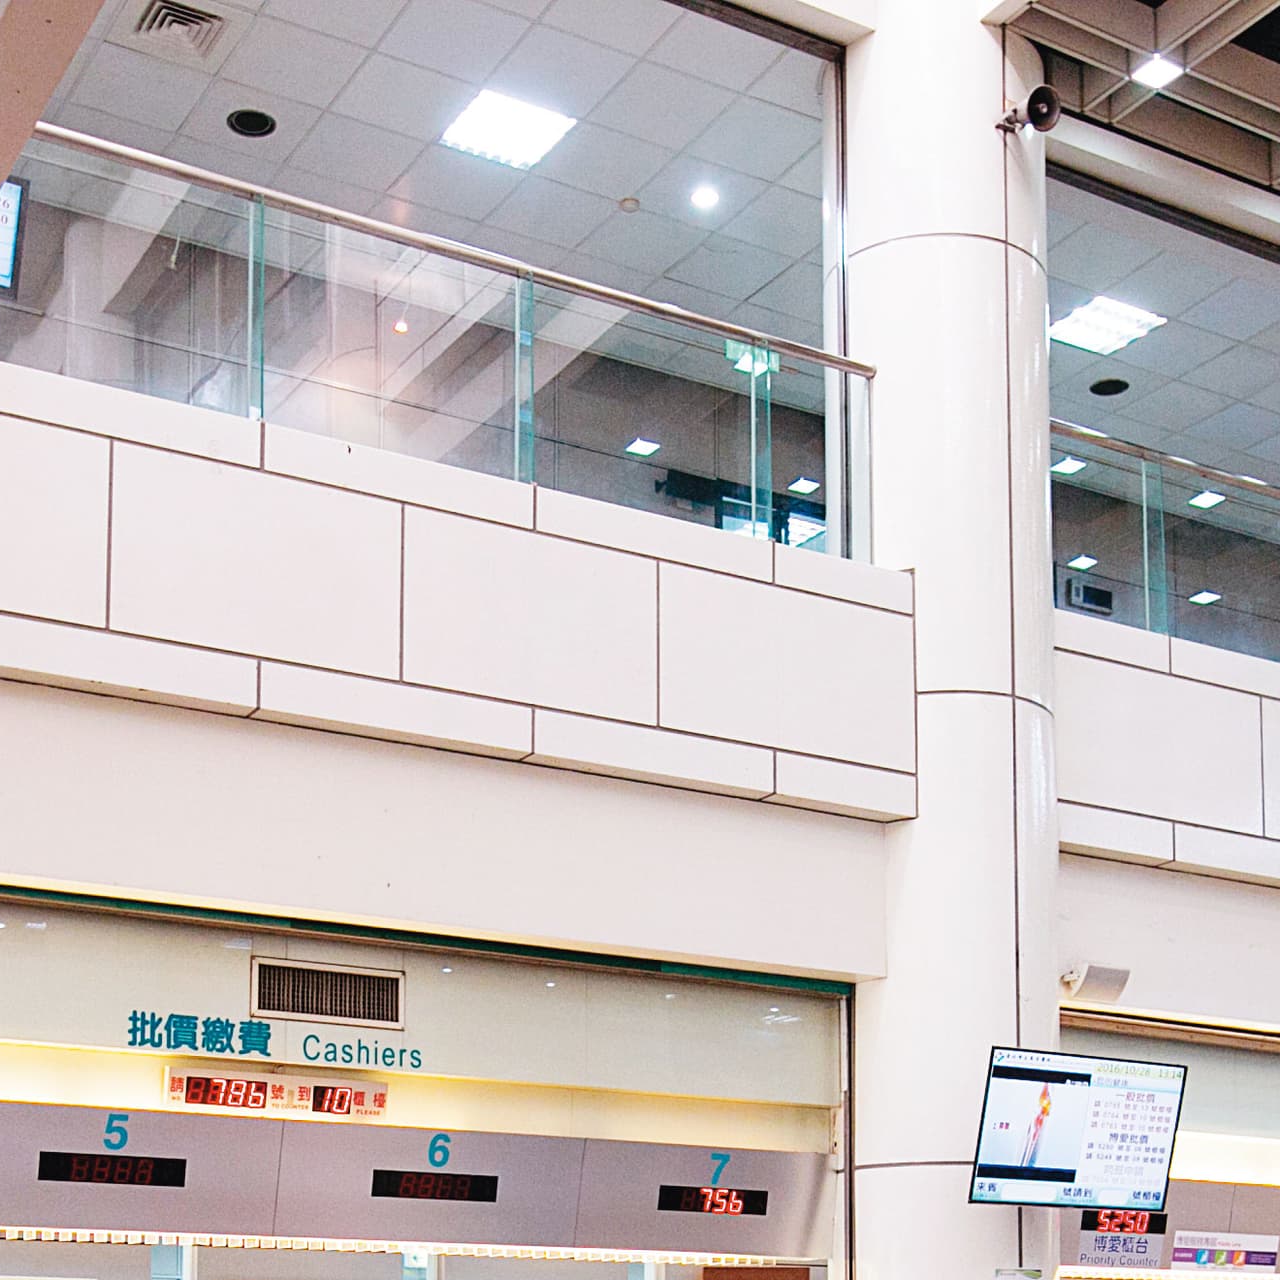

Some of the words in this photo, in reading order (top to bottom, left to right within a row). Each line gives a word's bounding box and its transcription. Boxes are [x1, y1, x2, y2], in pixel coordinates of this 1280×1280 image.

[127, 1010, 272, 1057] 批價繳費
[302, 1034, 422, 1069] Cashiers
[212, 1078, 265, 1108] 786
[323, 1088, 352, 1113] 10
[103, 1113, 130, 1150] 5
[427, 1133, 451, 1168] 6
[710, 1152, 731, 1185] 7
[699, 1187, 744, 1215] 756
[1097, 1209, 1150, 1234] 5250
[1079, 1252, 1117, 1266] Priority
[1119, 1255, 1159, 1267] Counter
[1093, 1235, 1150, 1253] 博愛櫃台
